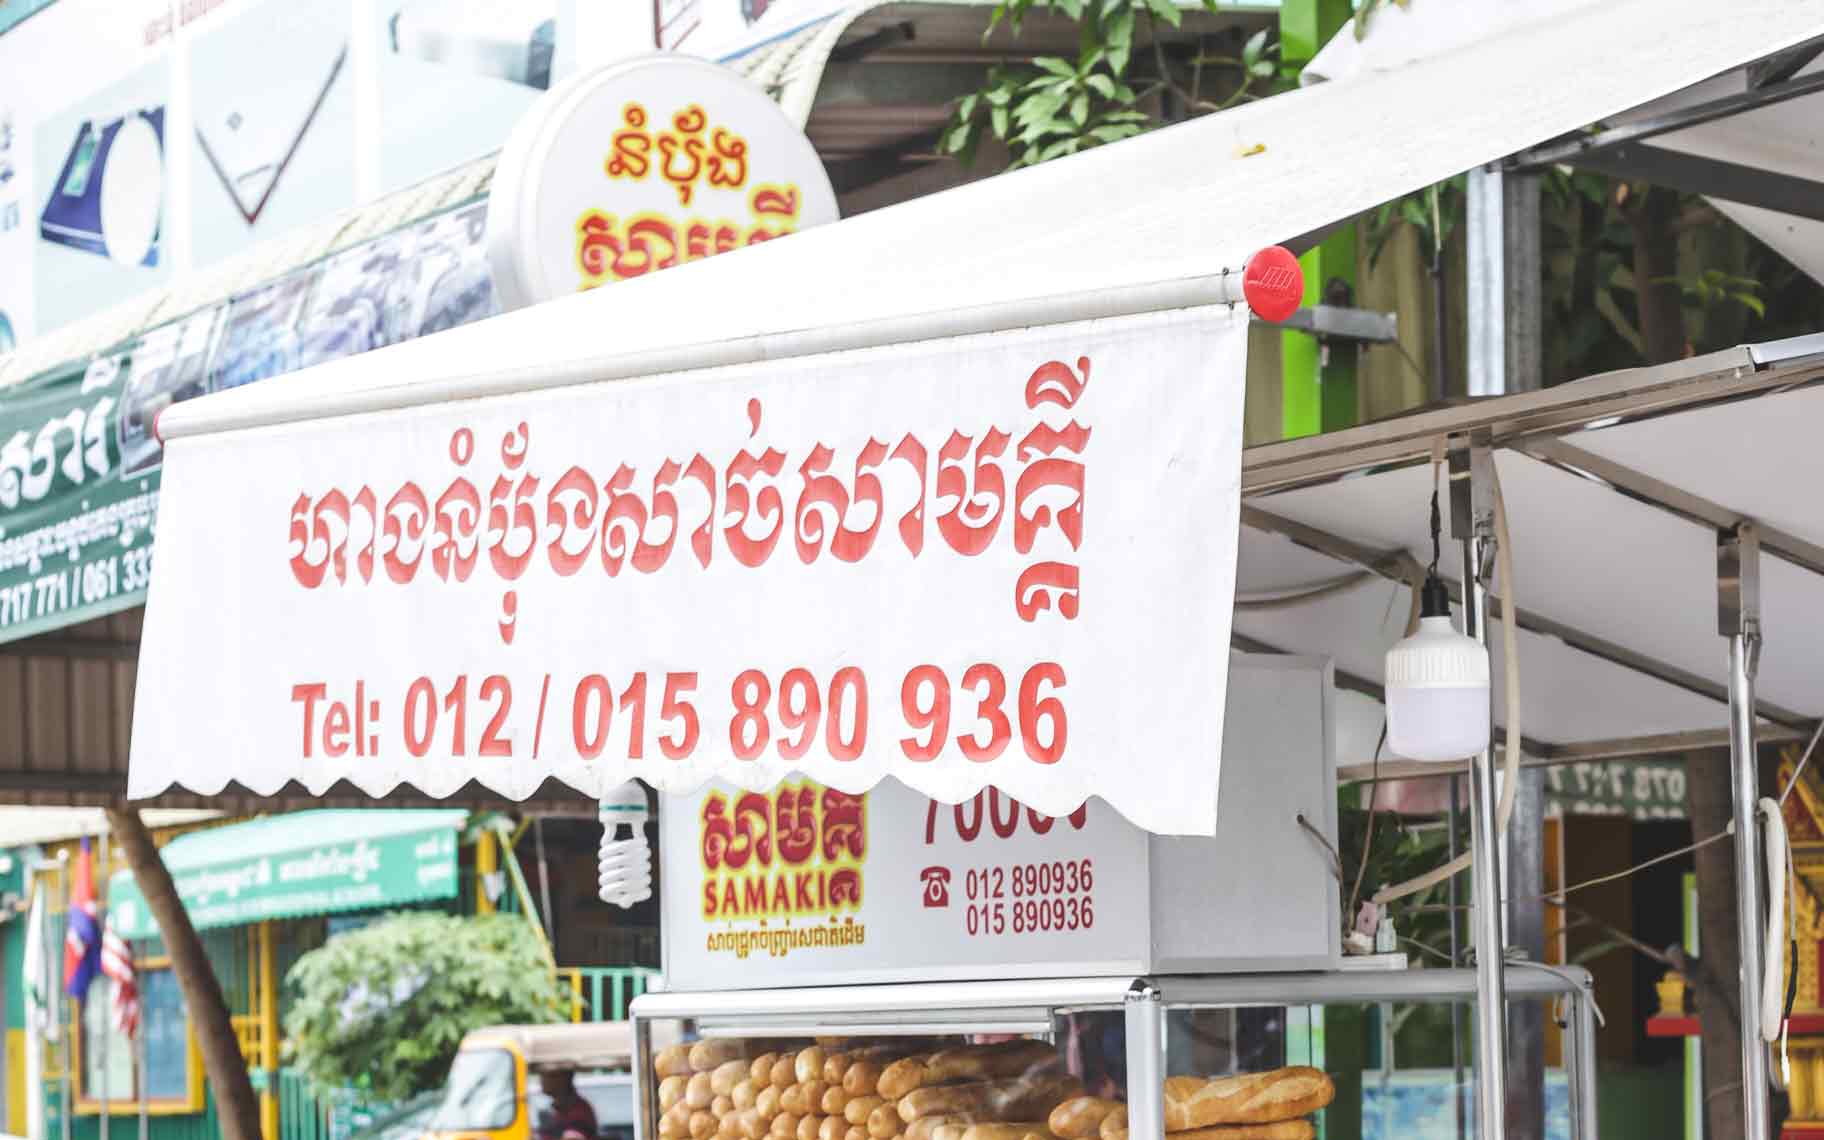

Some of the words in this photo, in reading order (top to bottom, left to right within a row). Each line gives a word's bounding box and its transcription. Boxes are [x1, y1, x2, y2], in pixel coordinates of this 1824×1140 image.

[291, 680, 380, 758] Tel:
[403, 673, 513, 758] 012
[532, 672, 551, 760] /
[572, 671, 700, 761] 015
[729, 666, 869, 763] 890
[899, 662, 1068, 765] 936
[704, 869, 826, 916] SAMAKI
[966, 867, 1004, 901] 012
[1012, 858, 1093, 898] 890936
[966, 903, 1005, 936] 015
[1012, 896, 1094, 934] 890936
